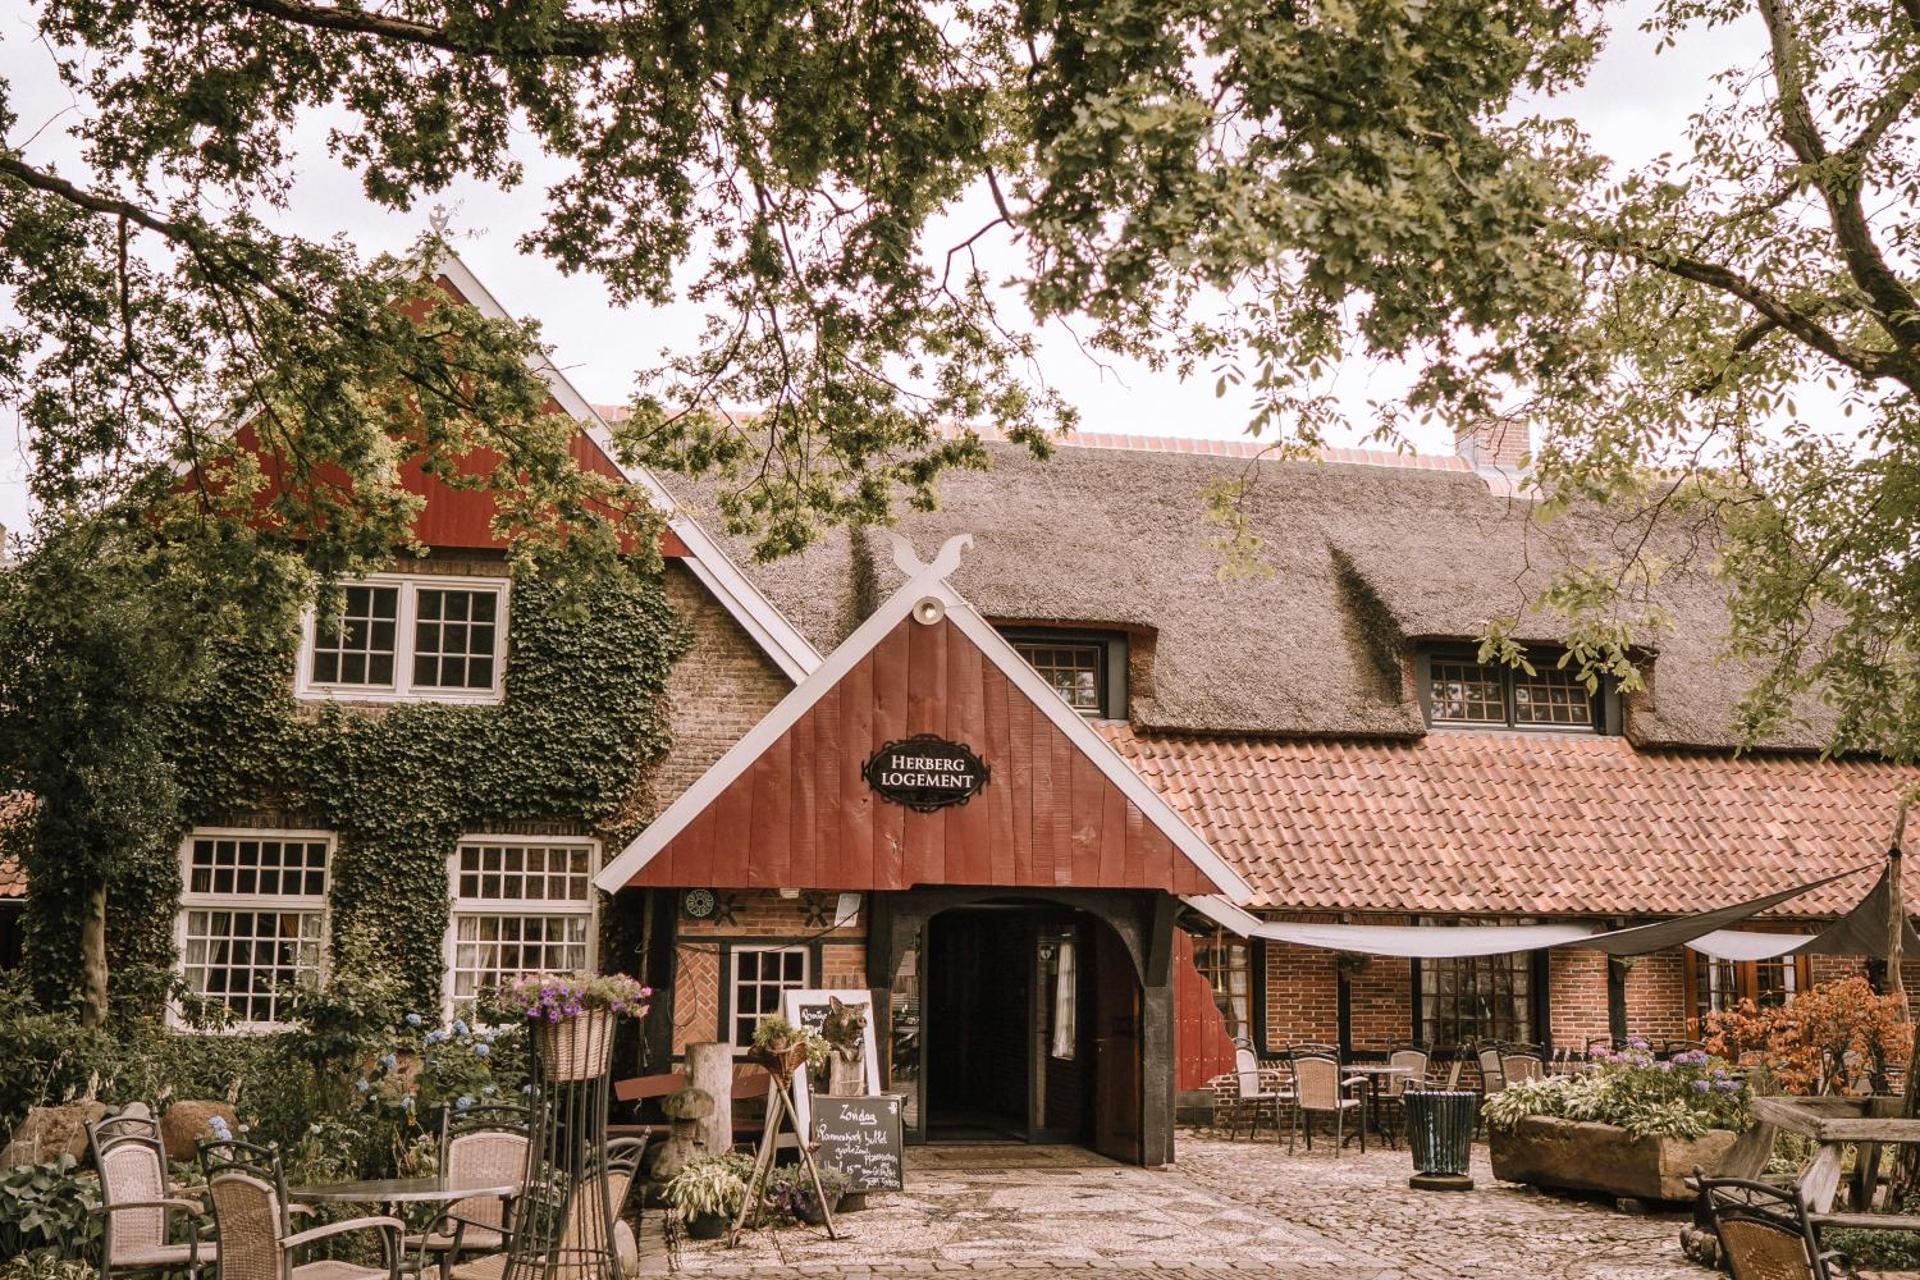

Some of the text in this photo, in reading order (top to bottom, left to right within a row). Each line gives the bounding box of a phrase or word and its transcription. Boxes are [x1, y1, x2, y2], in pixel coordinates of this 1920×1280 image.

[891, 754, 965, 772] HERBERG
[881, 772, 974, 788] LOGEMENT
[839, 1103, 877, 1125] Zondag
